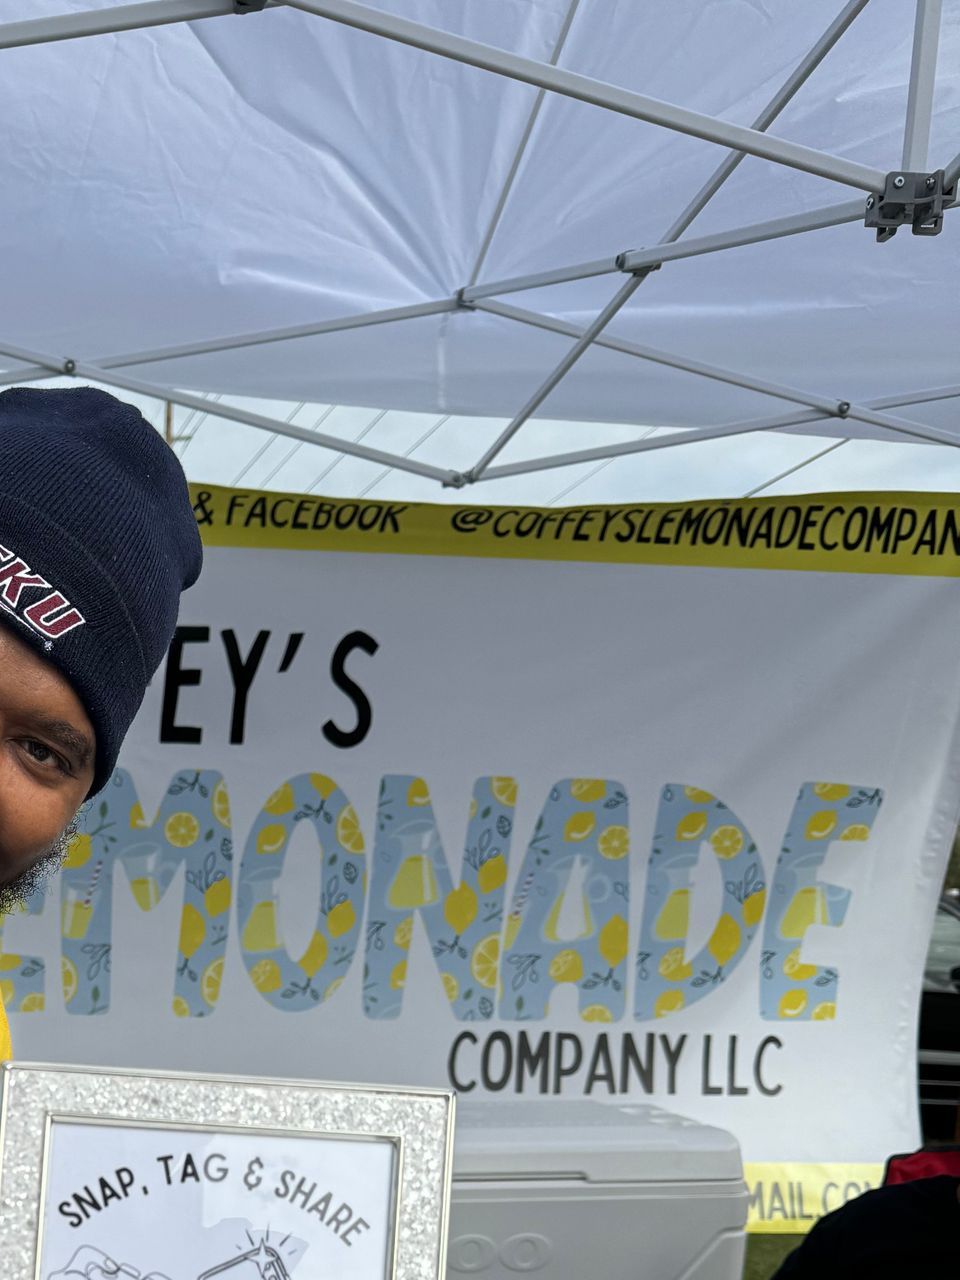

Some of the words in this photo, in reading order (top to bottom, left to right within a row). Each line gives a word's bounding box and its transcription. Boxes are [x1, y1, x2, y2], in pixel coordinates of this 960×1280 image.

[226, 495, 409, 533] FACEBOOK
[448, 1030, 688, 1095] COMPANY
[702, 1034, 783, 1096] LLC
[58, 1166, 150, 1229] SNAP,
[157, 1152, 229, 1185] TAG
[243, 1156, 265, 1191] &
[274, 1169, 371, 1247] SHARE
